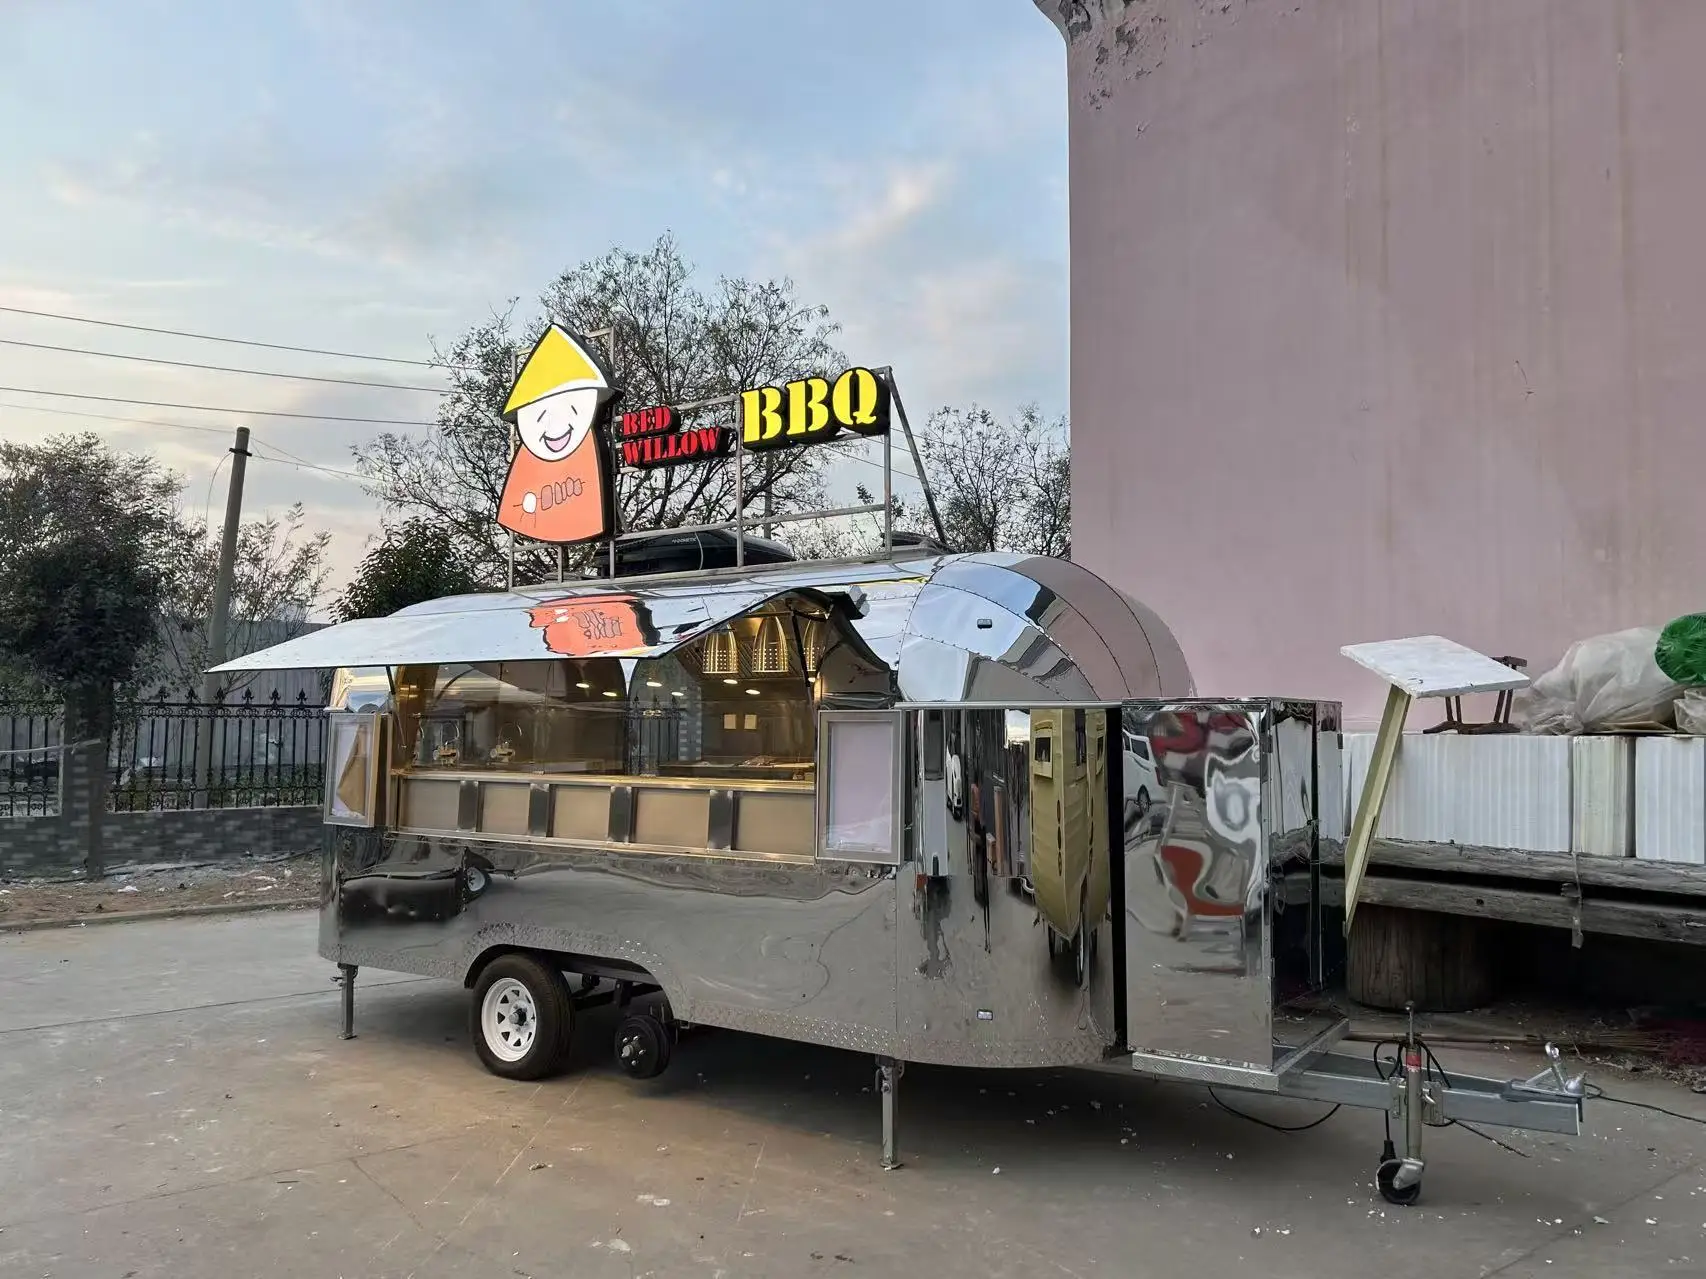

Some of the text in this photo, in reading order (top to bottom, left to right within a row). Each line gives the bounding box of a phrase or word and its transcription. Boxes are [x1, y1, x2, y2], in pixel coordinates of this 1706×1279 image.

[622, 405, 671, 436] RED
[741, 368, 878, 443] BBQ
[622, 427, 720, 465] WILLOW
